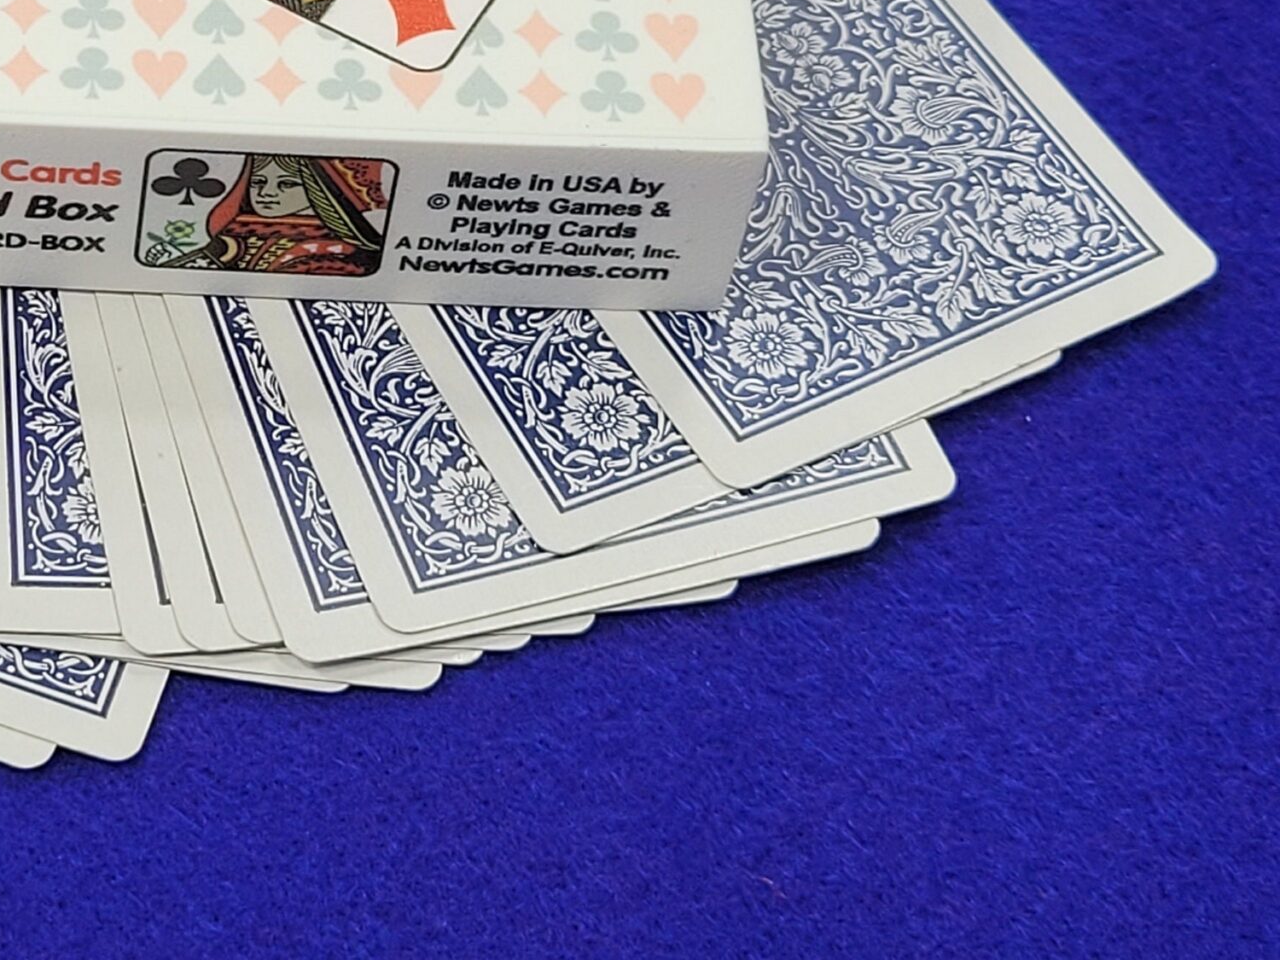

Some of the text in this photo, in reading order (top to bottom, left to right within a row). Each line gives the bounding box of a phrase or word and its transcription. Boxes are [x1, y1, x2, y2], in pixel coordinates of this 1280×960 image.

[0, 159, 123, 187] Cards
[447, 171, 665, 198] Made in USA by
[25, 196, 120, 222] Box
[457, 195, 539, 214] Newts
[549, 198, 642, 217] Games
[650, 201, 672, 218] &
[450, 217, 638, 239] Playing Cards
[395, 237, 681, 260] A Division of E-Quiver, Inc.
[398, 255, 669, 281] NewtsGames.com
